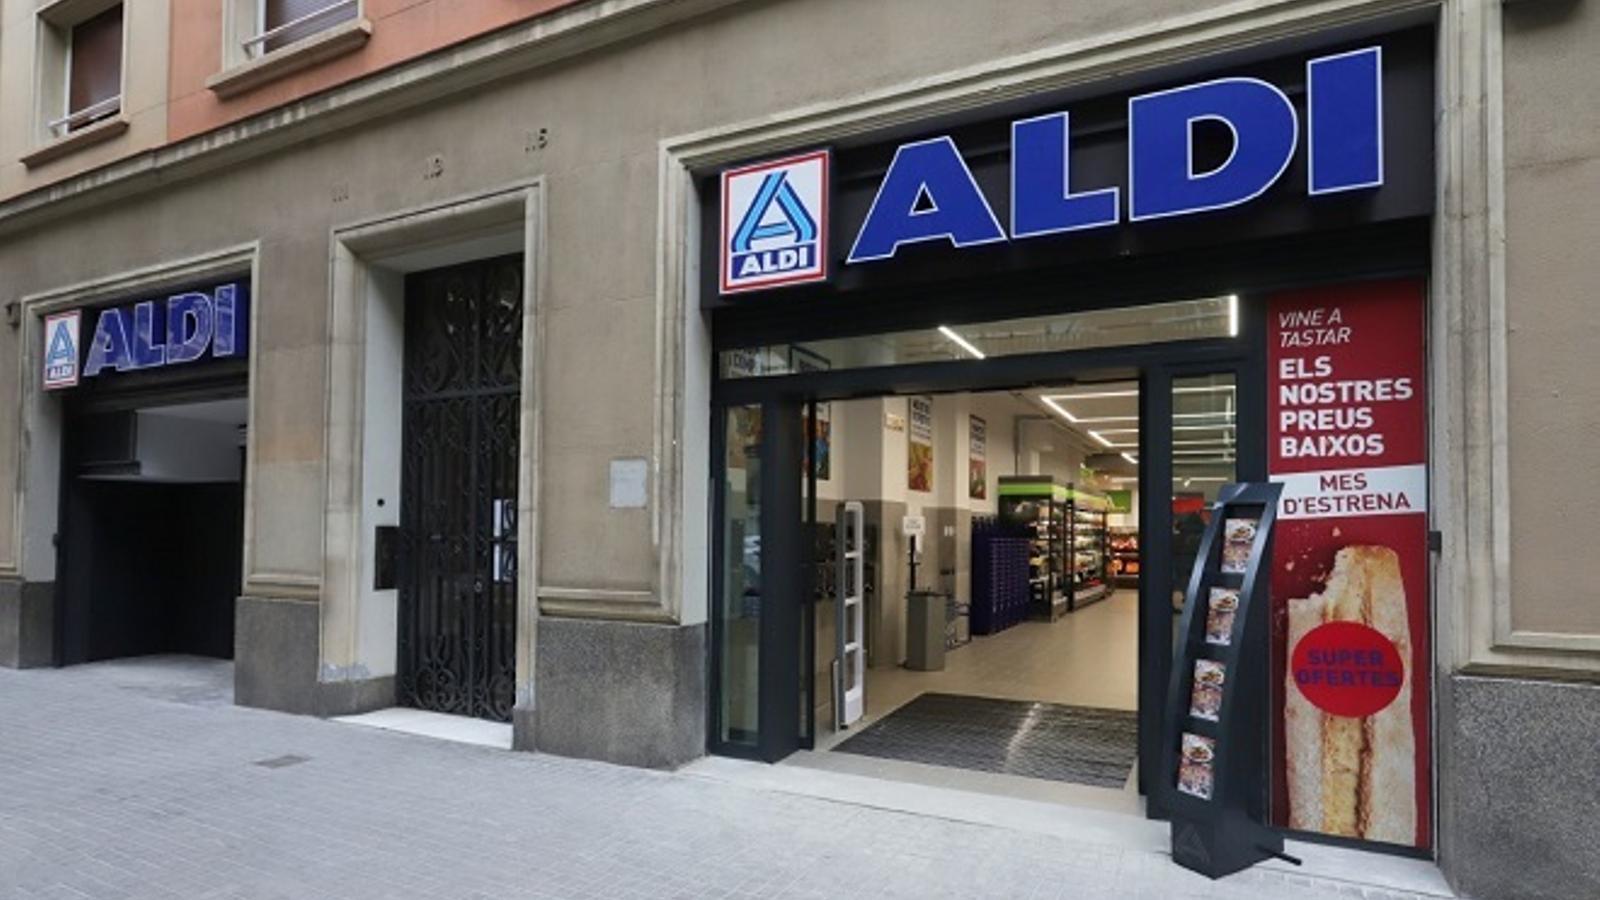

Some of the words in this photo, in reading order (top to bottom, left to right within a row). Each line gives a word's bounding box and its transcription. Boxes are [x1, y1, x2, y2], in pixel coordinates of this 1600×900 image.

[847, 46, 1383, 263] ALDI
[739, 247, 808, 277] ALDI
[83, 283, 236, 376] ALDI
[1279, 310, 1322, 328] VINE
[1328, 308, 1342, 325] A
[1279, 326, 1351, 347] TASTAR
[1280, 356, 1332, 379] ELS
[1280, 378, 1413, 406] NOSTRES
[1280, 407, 1373, 432] PREUS
[1280, 434, 1385, 459] BAIXOS
[1320, 473, 1368, 491] MES
[1283, 492, 1411, 515] D'ESTRENA
[1308, 649, 1384, 665] SUPER
[1298, 668, 1400, 687] OFERTES
